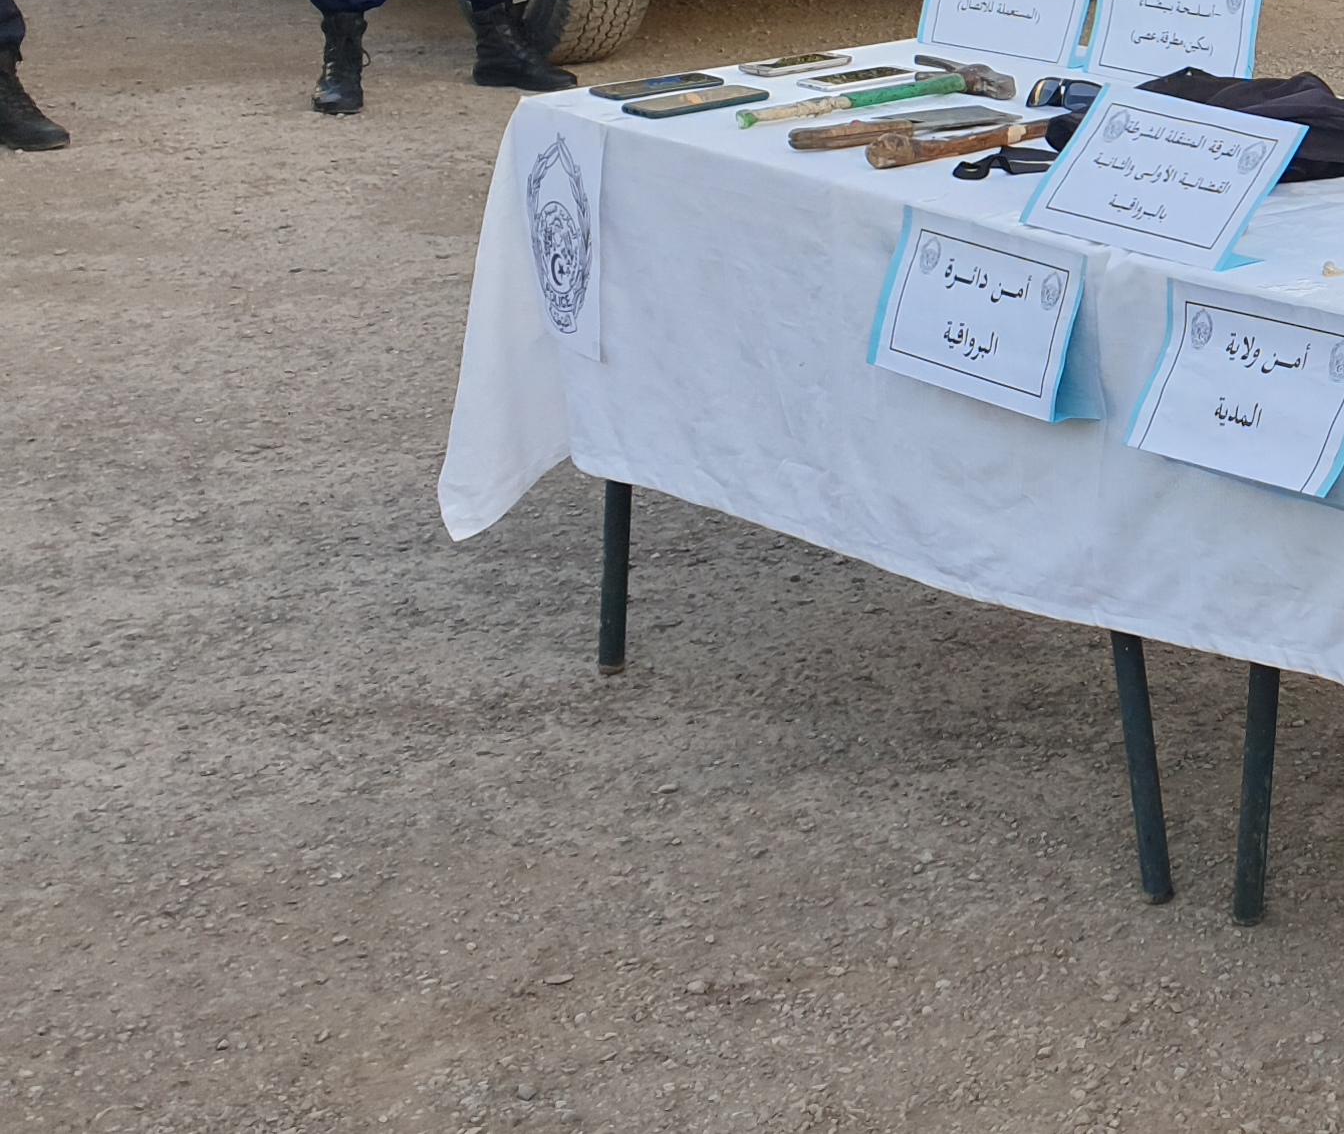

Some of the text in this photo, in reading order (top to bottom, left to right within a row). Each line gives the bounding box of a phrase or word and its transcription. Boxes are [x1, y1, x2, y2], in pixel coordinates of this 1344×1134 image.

[1125, 120, 1242, 160] الفرقة المتنقلة للشرطة
[1093, 152, 1136, 177] والثانية
[1179, 172, 1231, 195] القضائية
[944, 258, 1032, 303] أمن دائرة
[943, 320, 999, 360] البرواقية
[1225, 332, 1311, 374] أمن ولاية
[1214, 396, 1263, 428] المدية
